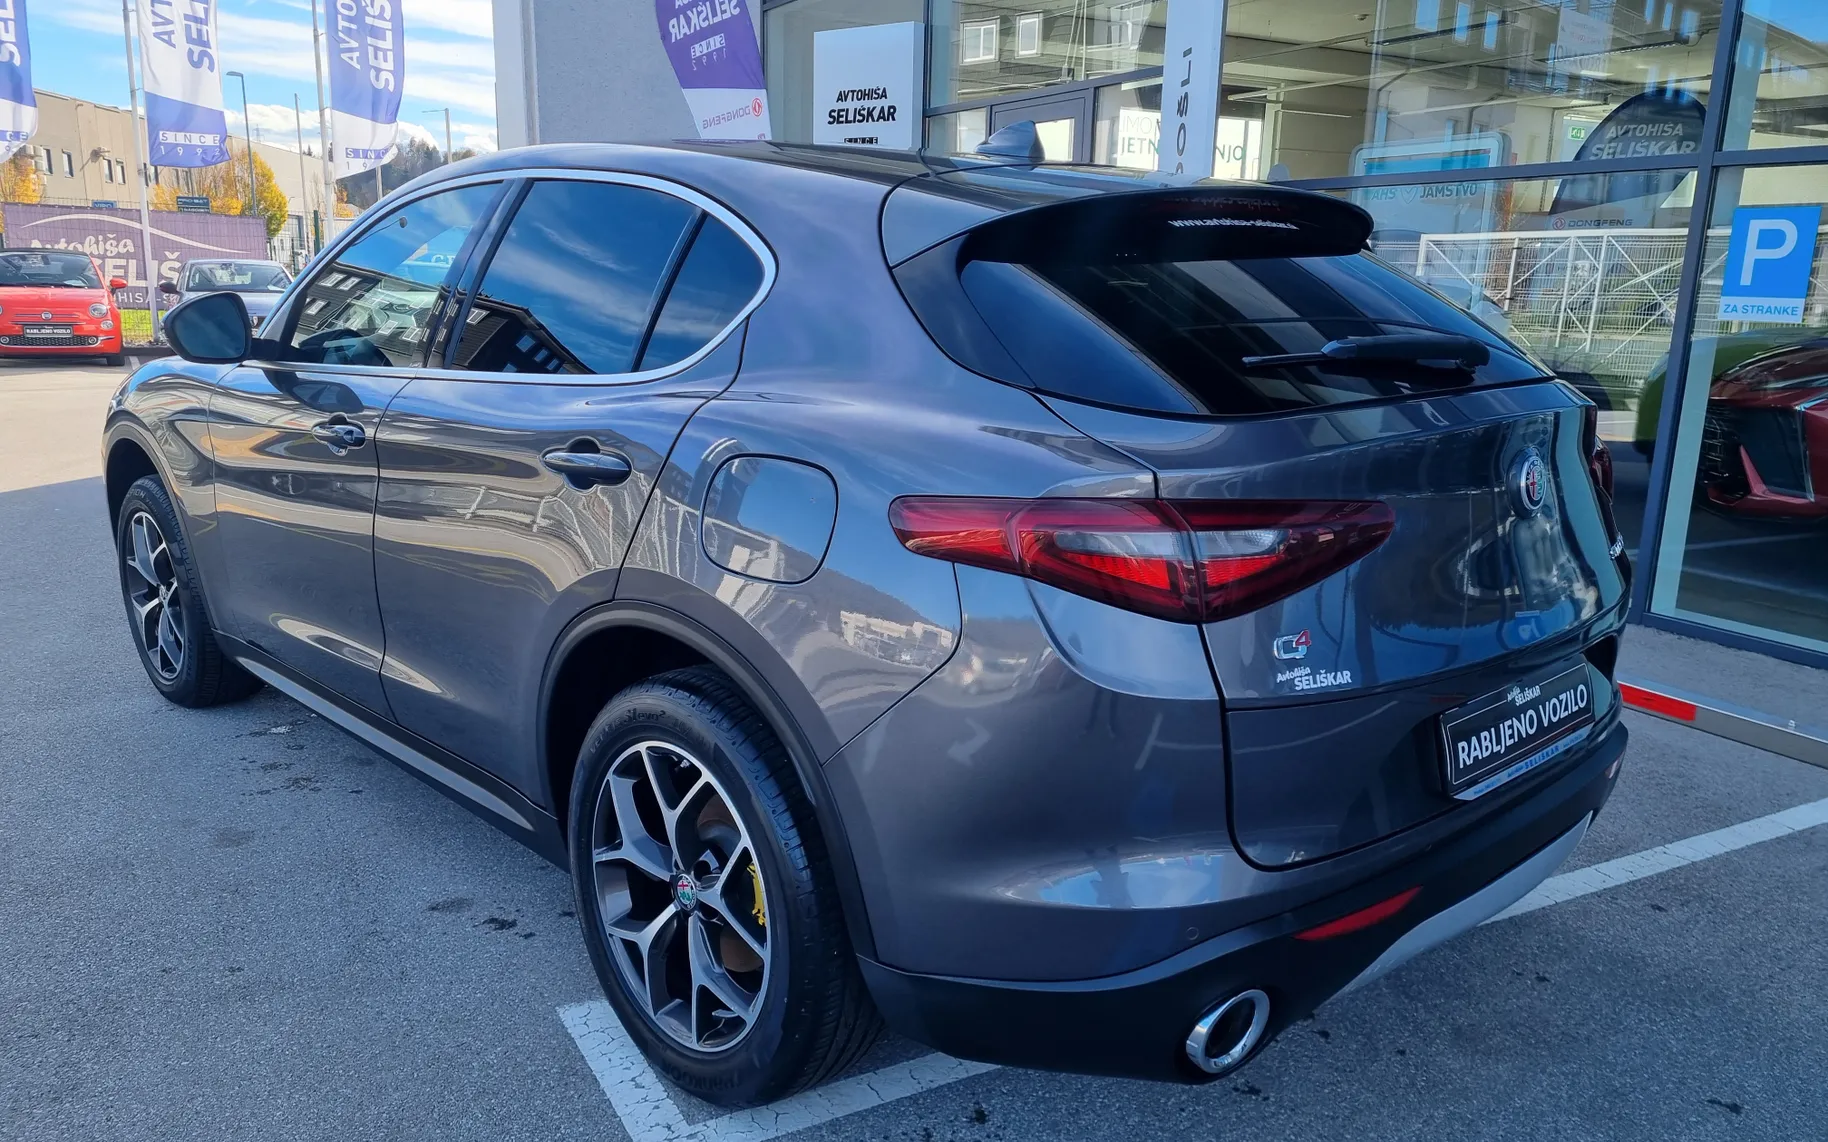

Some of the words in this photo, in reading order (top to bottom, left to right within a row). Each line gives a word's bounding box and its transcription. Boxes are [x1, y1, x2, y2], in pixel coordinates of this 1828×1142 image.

[183, 0, 215, 73] SEL
[836, 86, 888, 103] AVTOHIŠA
[827, 105, 897, 125] SELIŠKAR
[161, 132, 220, 145] SINCE
[1605, 122, 1684, 139] AVTOHIŠA
[160, 146, 221, 156] 1992
[1370, 188, 1398, 200] AHS
[1420, 183, 1478, 199] JAMSTVO
[1568, 218, 1634, 228] DONGFENG
[1739, 218, 1799, 287] P
[97, 251, 182, 288] ELIŠ
[1723, 303, 1739, 314] ZA
[1741, 304, 1800, 316] STRANKE
[1294, 669, 1353, 691] SELIŠKAR
[1457, 709, 1538, 770] RABLJENO
[1539, 683, 1589, 728] VOZILO
